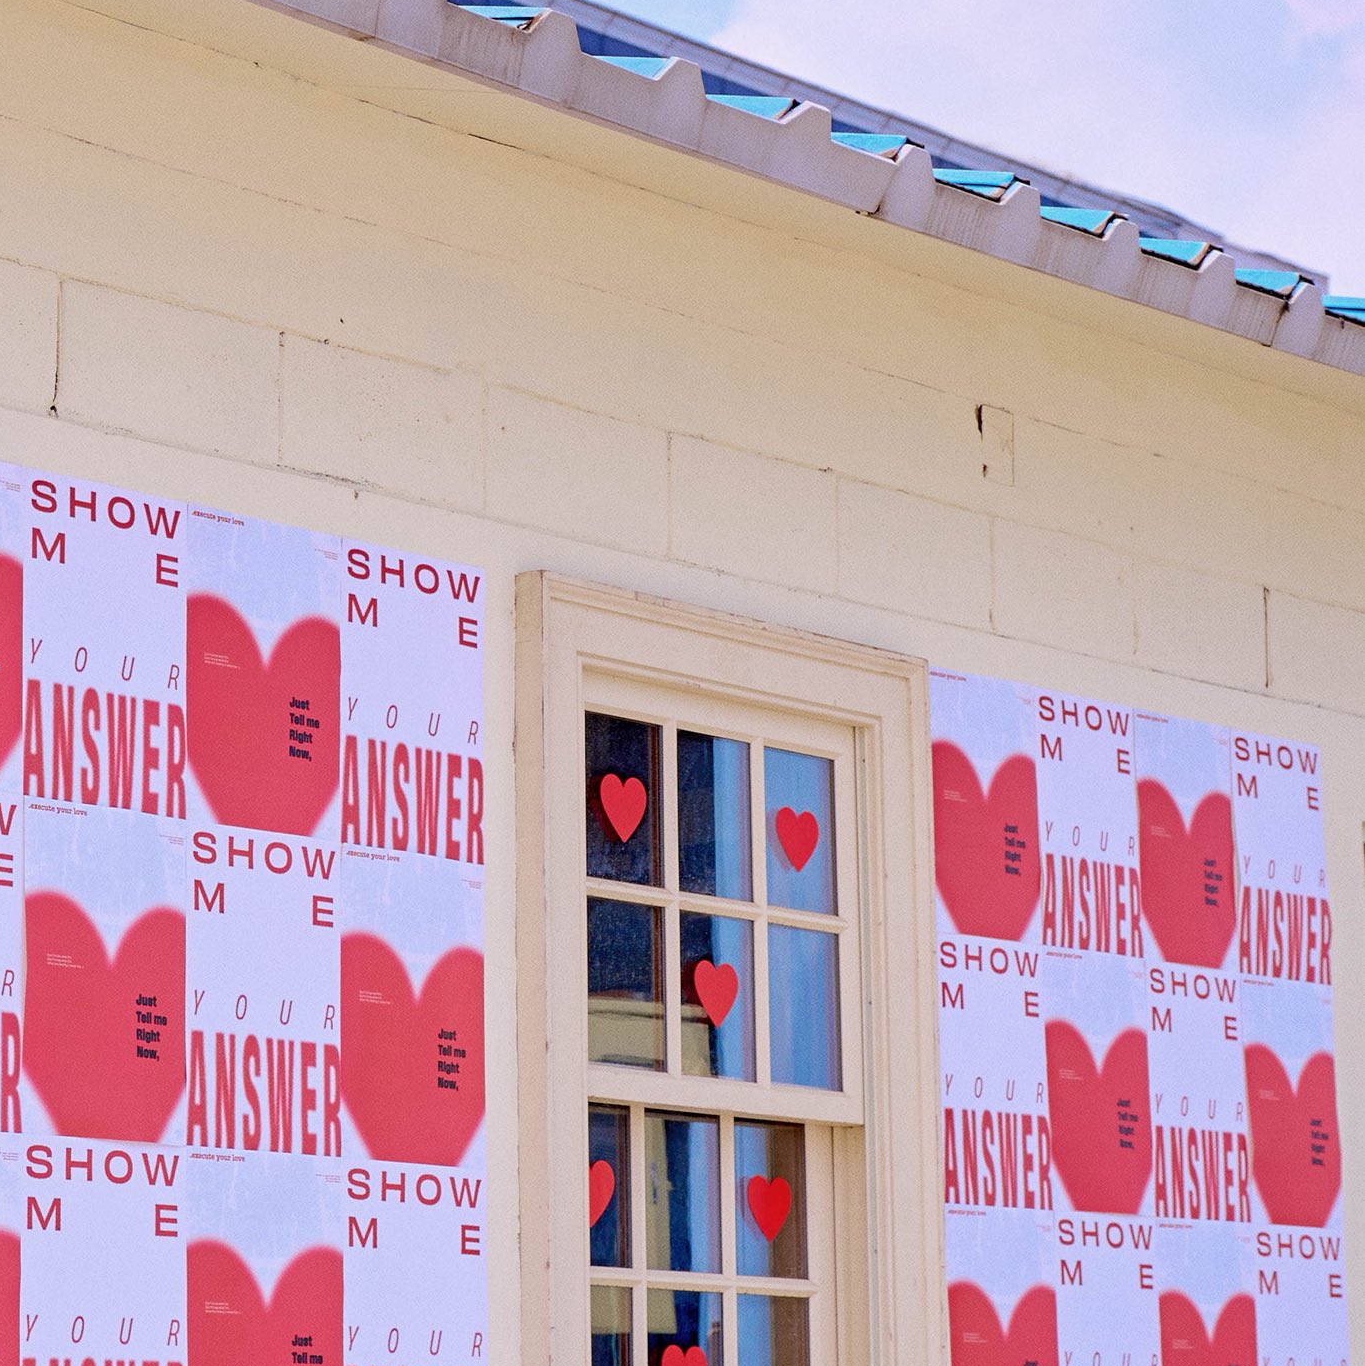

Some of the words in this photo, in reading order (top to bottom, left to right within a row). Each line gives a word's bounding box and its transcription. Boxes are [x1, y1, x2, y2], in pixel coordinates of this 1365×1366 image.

[30, 479, 181, 540] SHOW
[216, 514, 231, 524] your
[232, 516, 244, 526] love
[346, 548, 480, 603] SHOW
[289, 697, 309, 710] Just
[1038, 695, 1129, 737] SHOW
[289, 729, 312, 743] Right
[290, 713, 304, 725] Tell
[307, 718, 319, 728] me
[23, 678, 186, 818] ANSWER
[1235, 737, 1318, 775] SHOW
[56, 805, 72, 816] your
[73, 806, 87, 816] love
[341, 735, 484, 865] ANSWER
[192, 832, 335, 880] SHOW
[1042, 853, 1143, 958] ANSWER
[1240, 886, 1331, 985] ANSWER
[940, 941, 1039, 979] SHOW
[136, 994, 156, 1007] Just
[1150, 969, 1236, 1002] SHOW
[136, 1011, 152, 1023] Tell
[154, 1015, 167, 1026] me
[438, 1029, 456, 1040] Just
[136, 1029, 160, 1043] Right
[438, 1044, 452, 1056] Tell
[454, 1049, 466, 1058] me
[438, 1061, 459, 1074] Right
[187, 1031, 340, 1155] ANSWER
[26, 1145, 179, 1187] SHOW
[216, 1154, 231, 1162] your
[232, 1153, 245, 1162] love
[944, 1108, 1053, 1211] ANSWER
[348, 1168, 481, 1209] SHOW
[1155, 1125, 1251, 1223] ANSWER
[1058, 1219, 1152, 1250] SHOW
[1256, 1233, 1341, 1261] SHOW
[292, 1335, 312, 1346] Just
[292, 1352, 307, 1364] Tell
[310, 1355, 323, 1364] me
